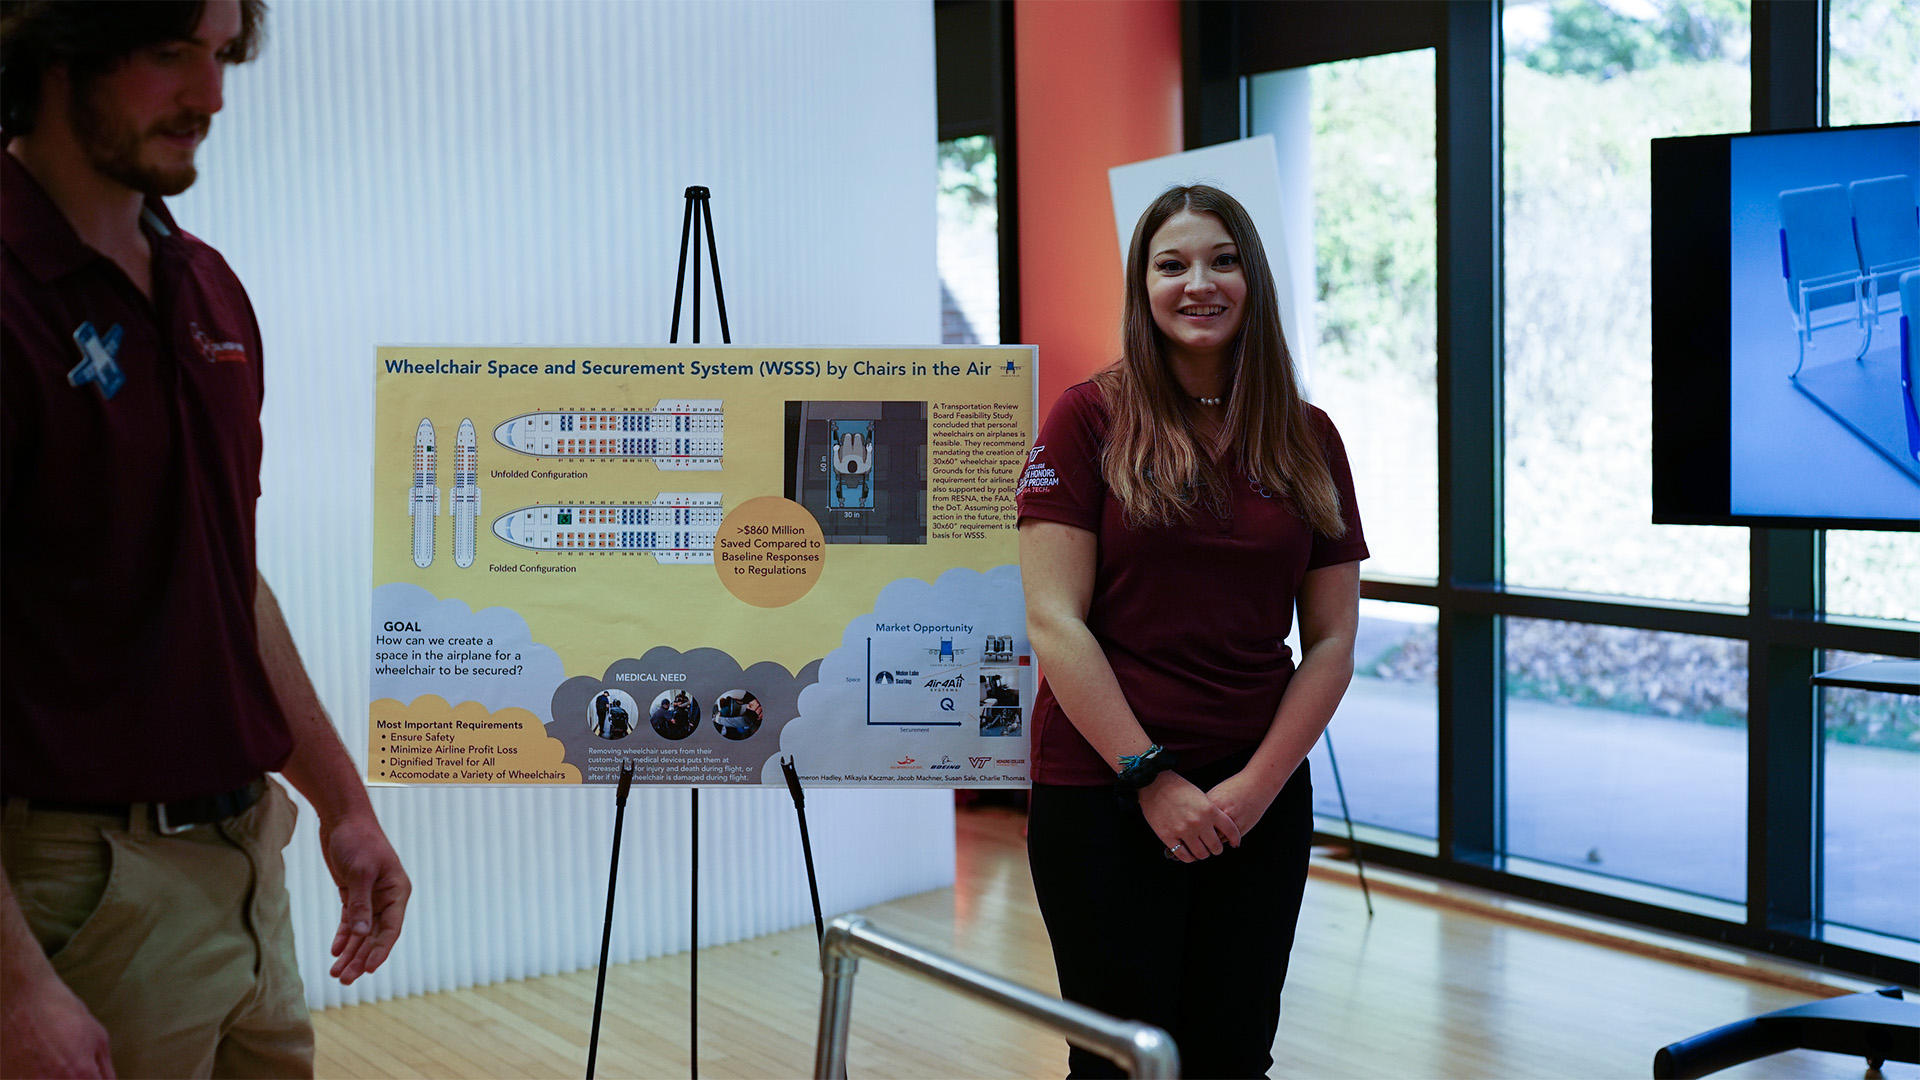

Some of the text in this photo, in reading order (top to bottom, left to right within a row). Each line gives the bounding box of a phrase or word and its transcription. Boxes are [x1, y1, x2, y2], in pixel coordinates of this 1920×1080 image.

[385, 359, 991, 379] Wheelchair Space and Securement System (WSSS) by Chairs in the Air
[988, 422, 1018, 430] personal
[987, 431, 1018, 439] airplanes
[964, 440, 981, 448] They
[820, 464, 828, 472] 60
[491, 470, 587, 480] Unfolded Configuration
[933, 477, 975, 485] requirement
[1028, 478, 1059, 486] PROGRAM
[949, 486, 985, 494] supported
[737, 525, 804, 535] >$860 Million
[960, 523, 1003, 531] requirement
[721, 539, 820, 549] Saved Compared to
[722, 552, 763, 561] Baseline
[767, 552, 819, 562] Responses
[490, 564, 576, 574] Folded Configuration
[749, 565, 806, 576] Regulations
[384, 622, 421, 632] GOAL
[876, 623, 973, 634] Market Opportunity
[377, 635, 402, 645] How
[448, 637, 483, 645] create
[376, 653, 408, 663] space
[412, 650, 421, 659] in
[425, 650, 443, 660] the
[447, 650, 491, 663] airplane
[495, 650, 511, 660] for
[375, 665, 523, 675] wheelchair to be secured?
[377, 720, 523, 731] Most Important Requirements
[391, 732, 455, 743] Ensure Safety
[391, 745, 517, 754] Minimize Airline Profit Loss
[589, 748, 621, 756] Removing
[390, 757, 495, 768] Dignified Travel for All
[701, 765, 723, 773] during
[725, 765, 743, 773] flight,
[390, 770, 450, 778] Accomodate
[461, 770, 493, 781] Variety
[496, 770, 506, 778] of
[509, 770, 565, 779] Wheelchairs
[673, 774, 704, 782] damaged
[706, 774, 728, 782] during
[729, 774, 748, 782] flight.
